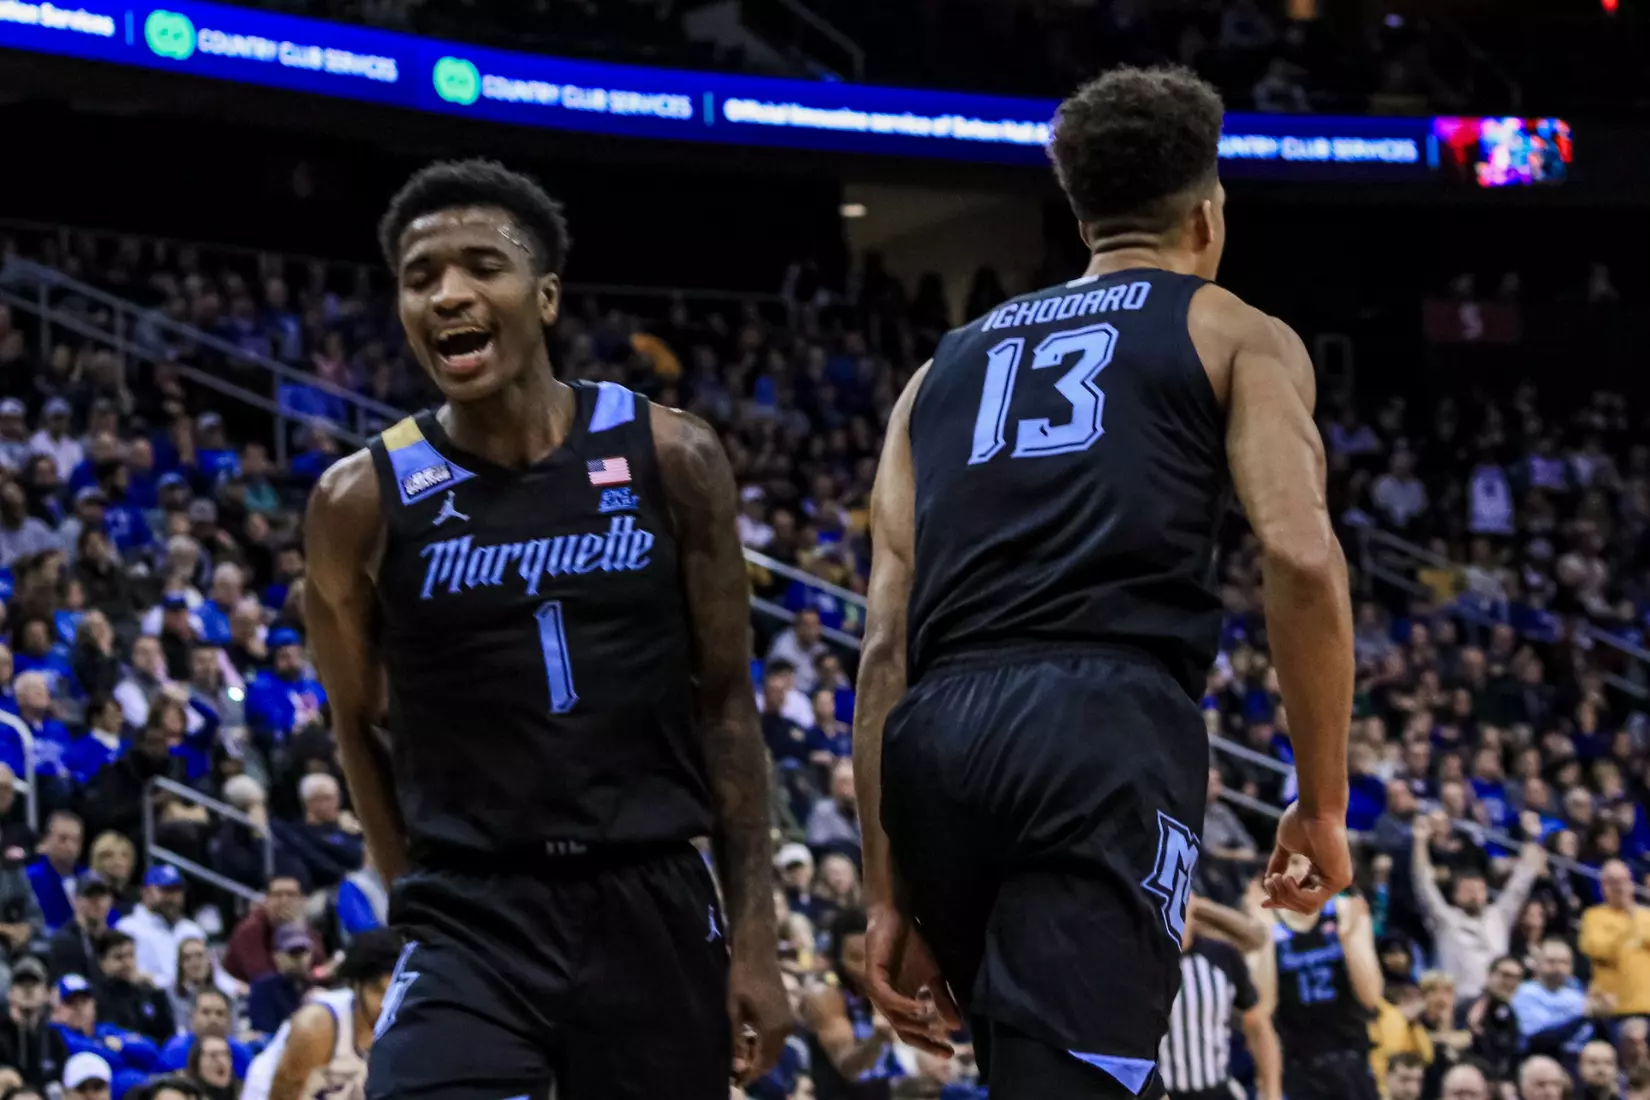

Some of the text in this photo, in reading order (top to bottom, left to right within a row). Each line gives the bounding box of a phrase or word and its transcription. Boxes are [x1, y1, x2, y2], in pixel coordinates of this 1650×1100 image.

[199, 28, 398, 82] COUNTRY CLUB SERVICES
[482, 74, 693, 119] COUNTRY CLUB SERVICES
[1281, 136, 1329, 159] CLUB
[1333, 138, 1418, 162] SERVICES
[981, 281, 1152, 332] IGHODARO
[967, 322, 1119, 465] 13
[420, 516, 655, 599] Marquette
[534, 600, 579, 714] 1
[1298, 965, 1337, 1004] 12
